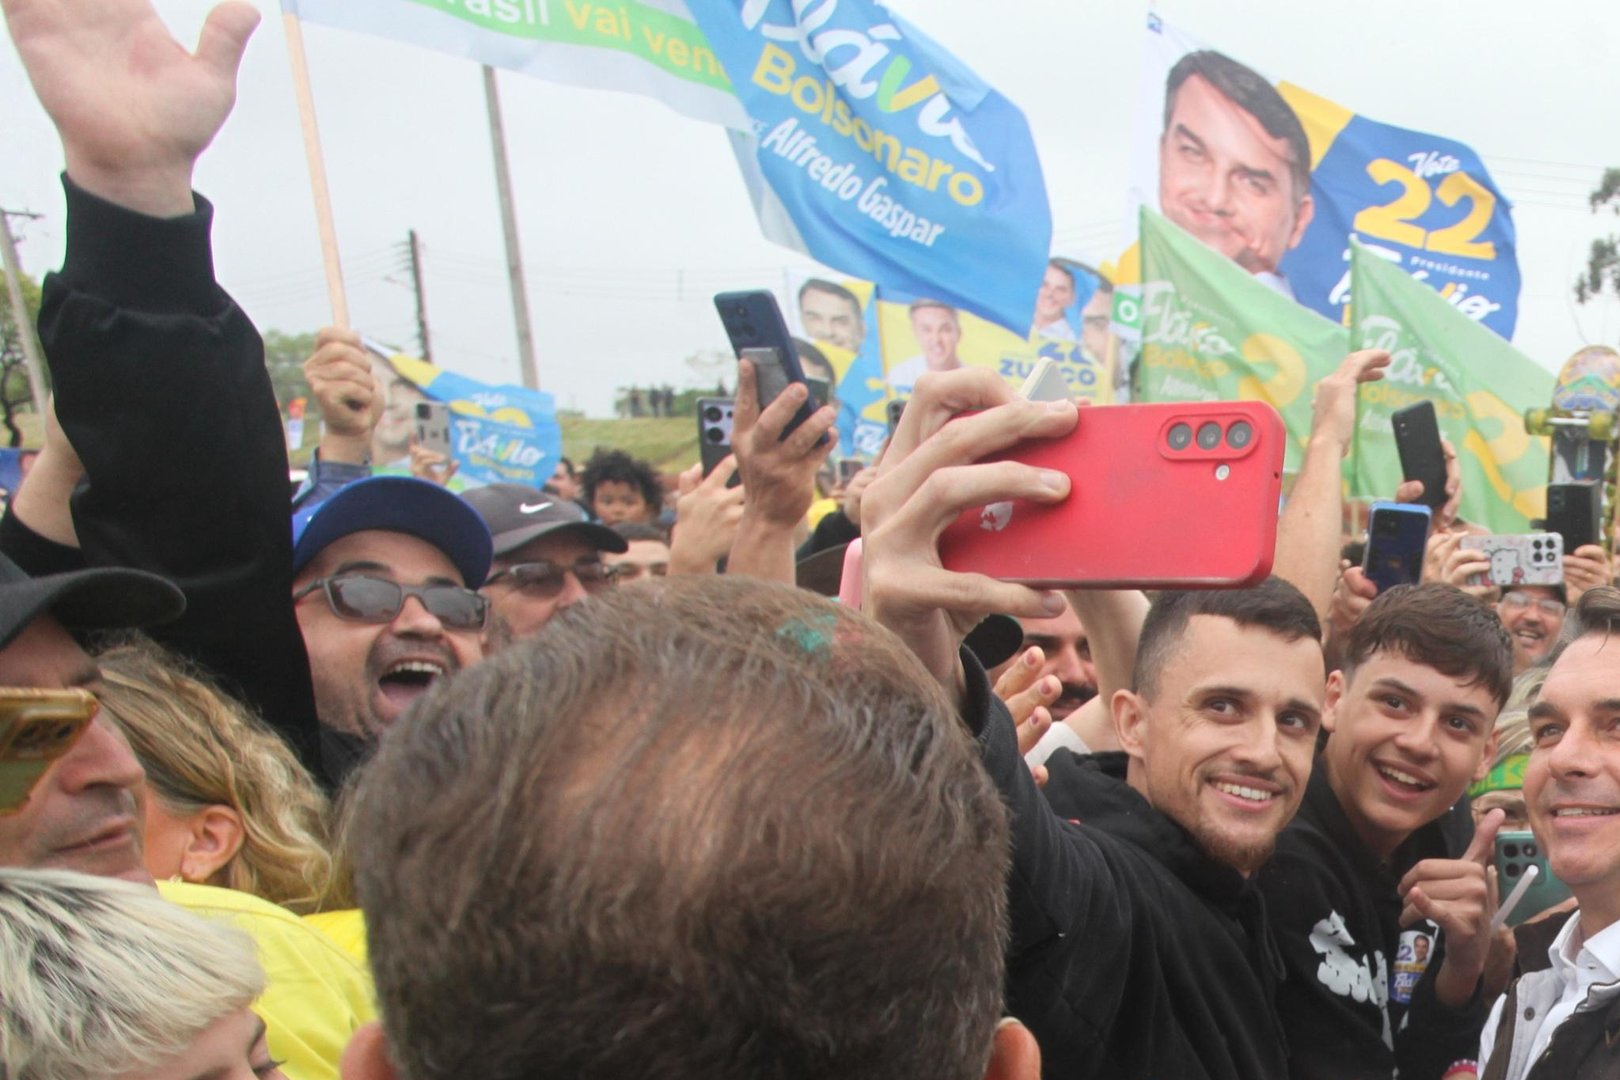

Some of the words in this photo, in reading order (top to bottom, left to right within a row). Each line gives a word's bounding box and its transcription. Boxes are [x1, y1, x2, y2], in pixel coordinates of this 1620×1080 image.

[446, 0, 551, 26] asil
[565, 2, 632, 42] Vai
[642, 24, 731, 85] ven
[752, 42, 984, 207] Bolsonaro
[1407, 151, 1460, 178] Vote
[761, 117, 863, 201] Alfredo
[857, 176, 945, 247] Gaspar
[1353, 158, 1497, 261] 22
[1410, 255, 1490, 281] Presidente
[999, 359, 1096, 386] ZUCO
